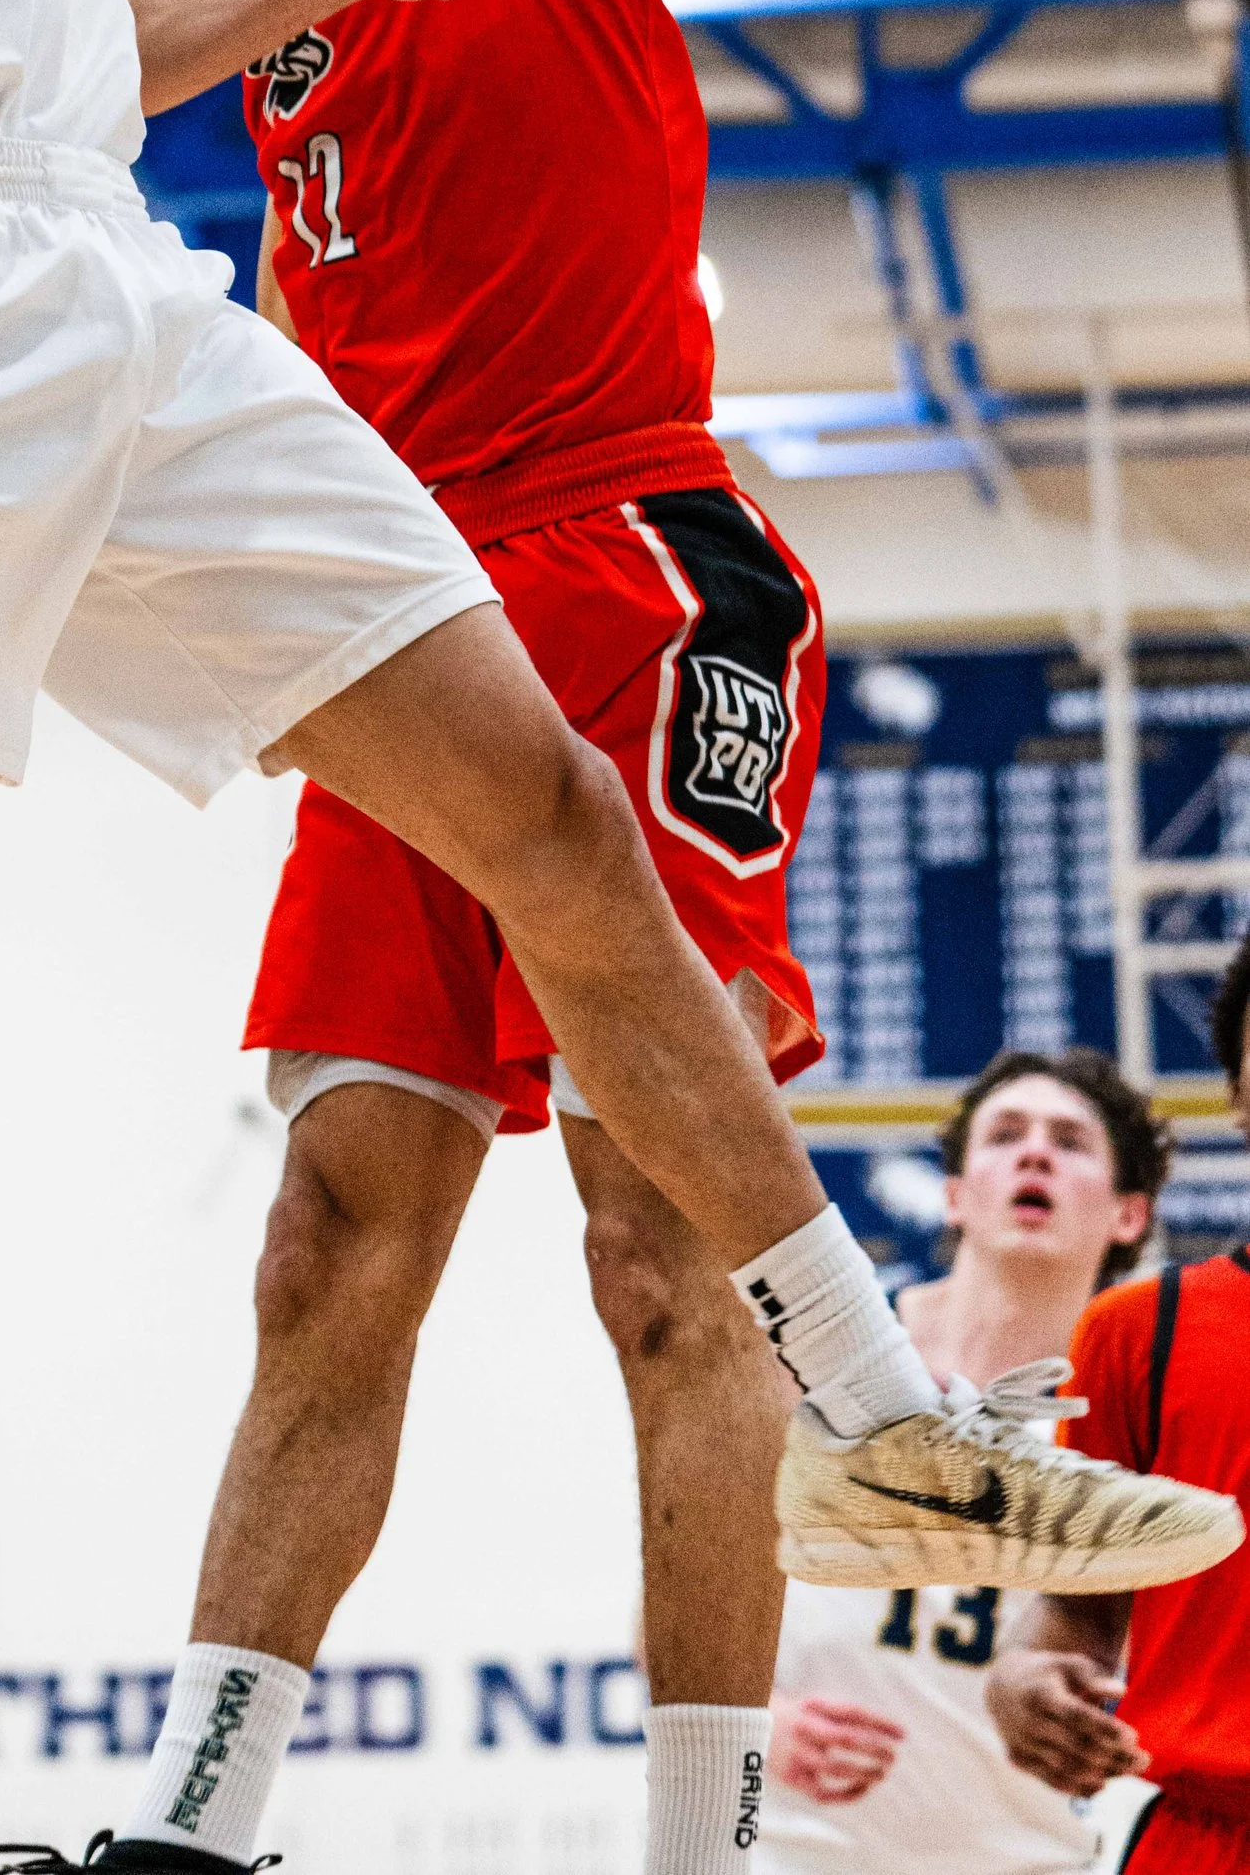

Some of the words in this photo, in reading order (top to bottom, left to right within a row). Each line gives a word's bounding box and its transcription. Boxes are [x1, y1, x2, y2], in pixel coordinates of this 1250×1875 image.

[711, 670, 775, 740] UT
[876, 1586, 1001, 1668] 13
[734, 1750, 763, 1849] GRIND
